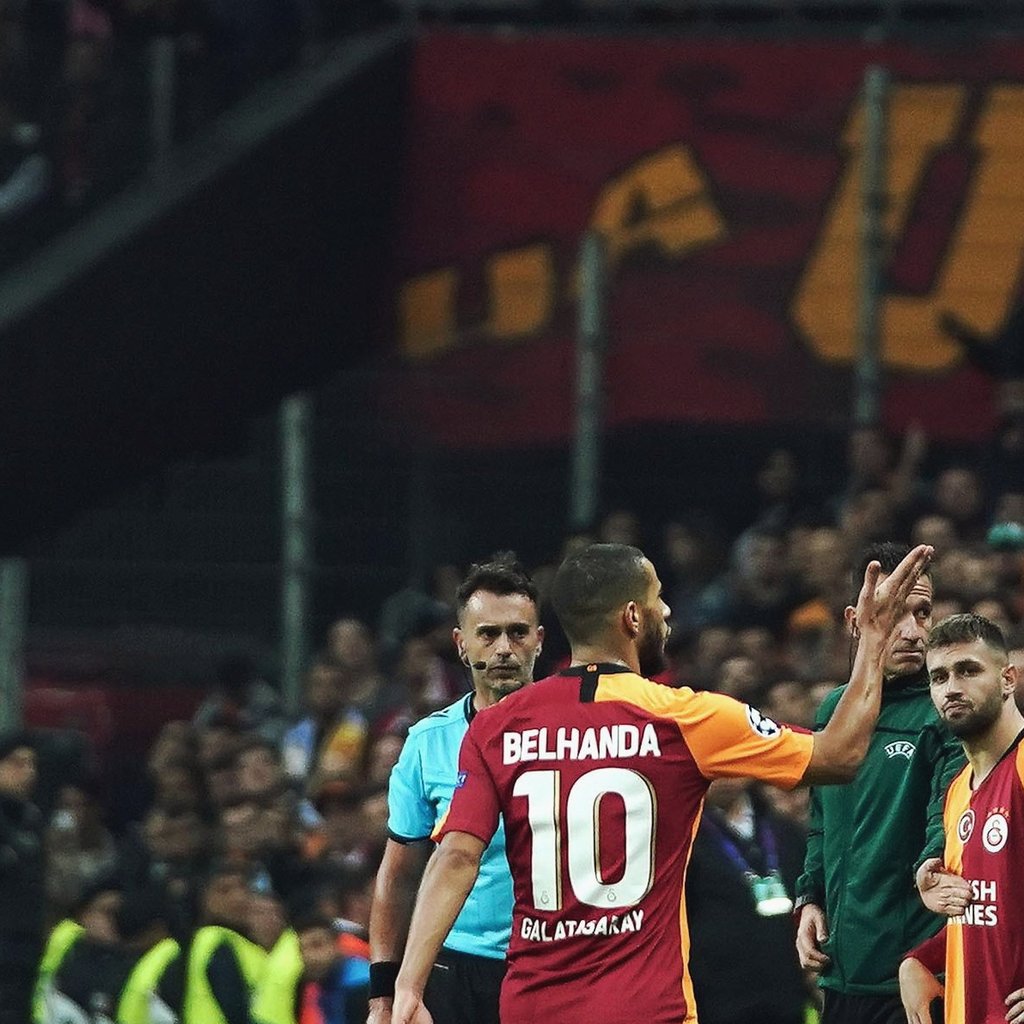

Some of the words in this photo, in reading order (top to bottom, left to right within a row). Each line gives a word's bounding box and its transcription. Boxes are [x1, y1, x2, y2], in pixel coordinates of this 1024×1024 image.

[503, 723, 662, 765] BELHANDA
[886, 743, 914, 757] UEFA
[512, 767, 658, 911] 10
